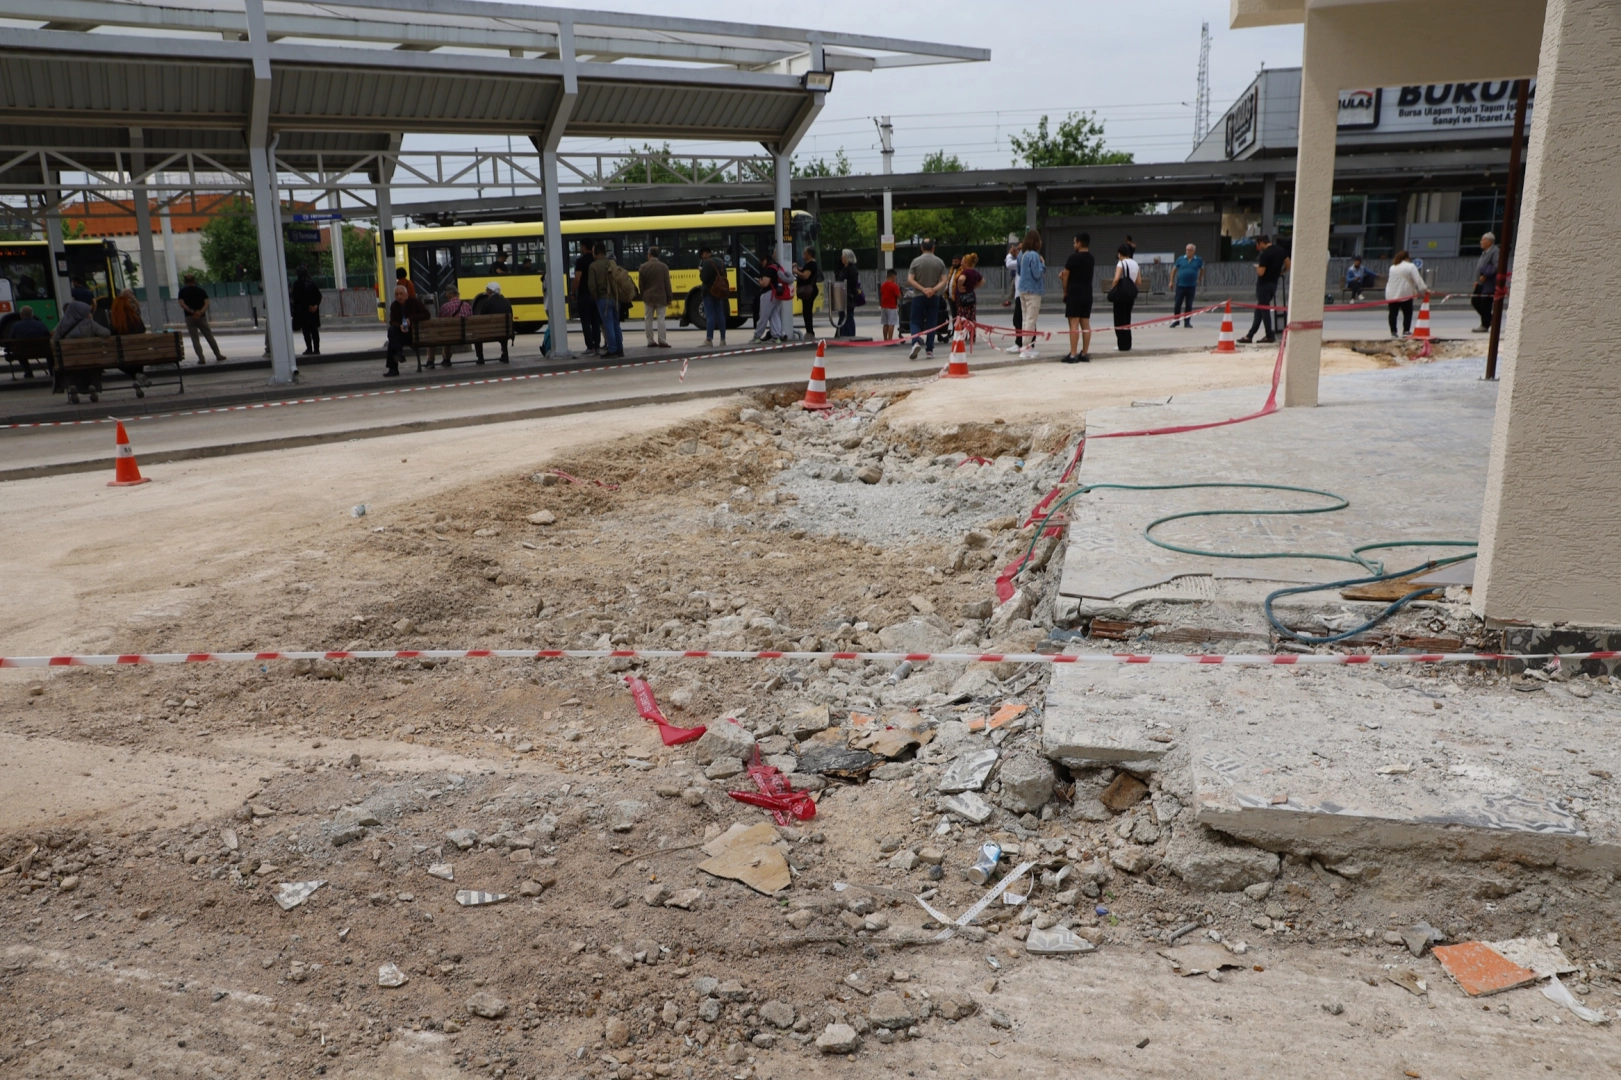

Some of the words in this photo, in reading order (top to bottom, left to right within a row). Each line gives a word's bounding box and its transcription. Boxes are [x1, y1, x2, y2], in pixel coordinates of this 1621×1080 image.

[1398, 108, 1422, 118] Bursa
[1424, 106, 1453, 116] Ulaşım
[1455, 105, 1478, 115] Toplu
[1480, 103, 1505, 113] Taşım
[1432, 116, 1460, 126] Sanayi
[1474, 113, 1503, 123] Ticaret
[639, 690, 652, 713] BURSA
